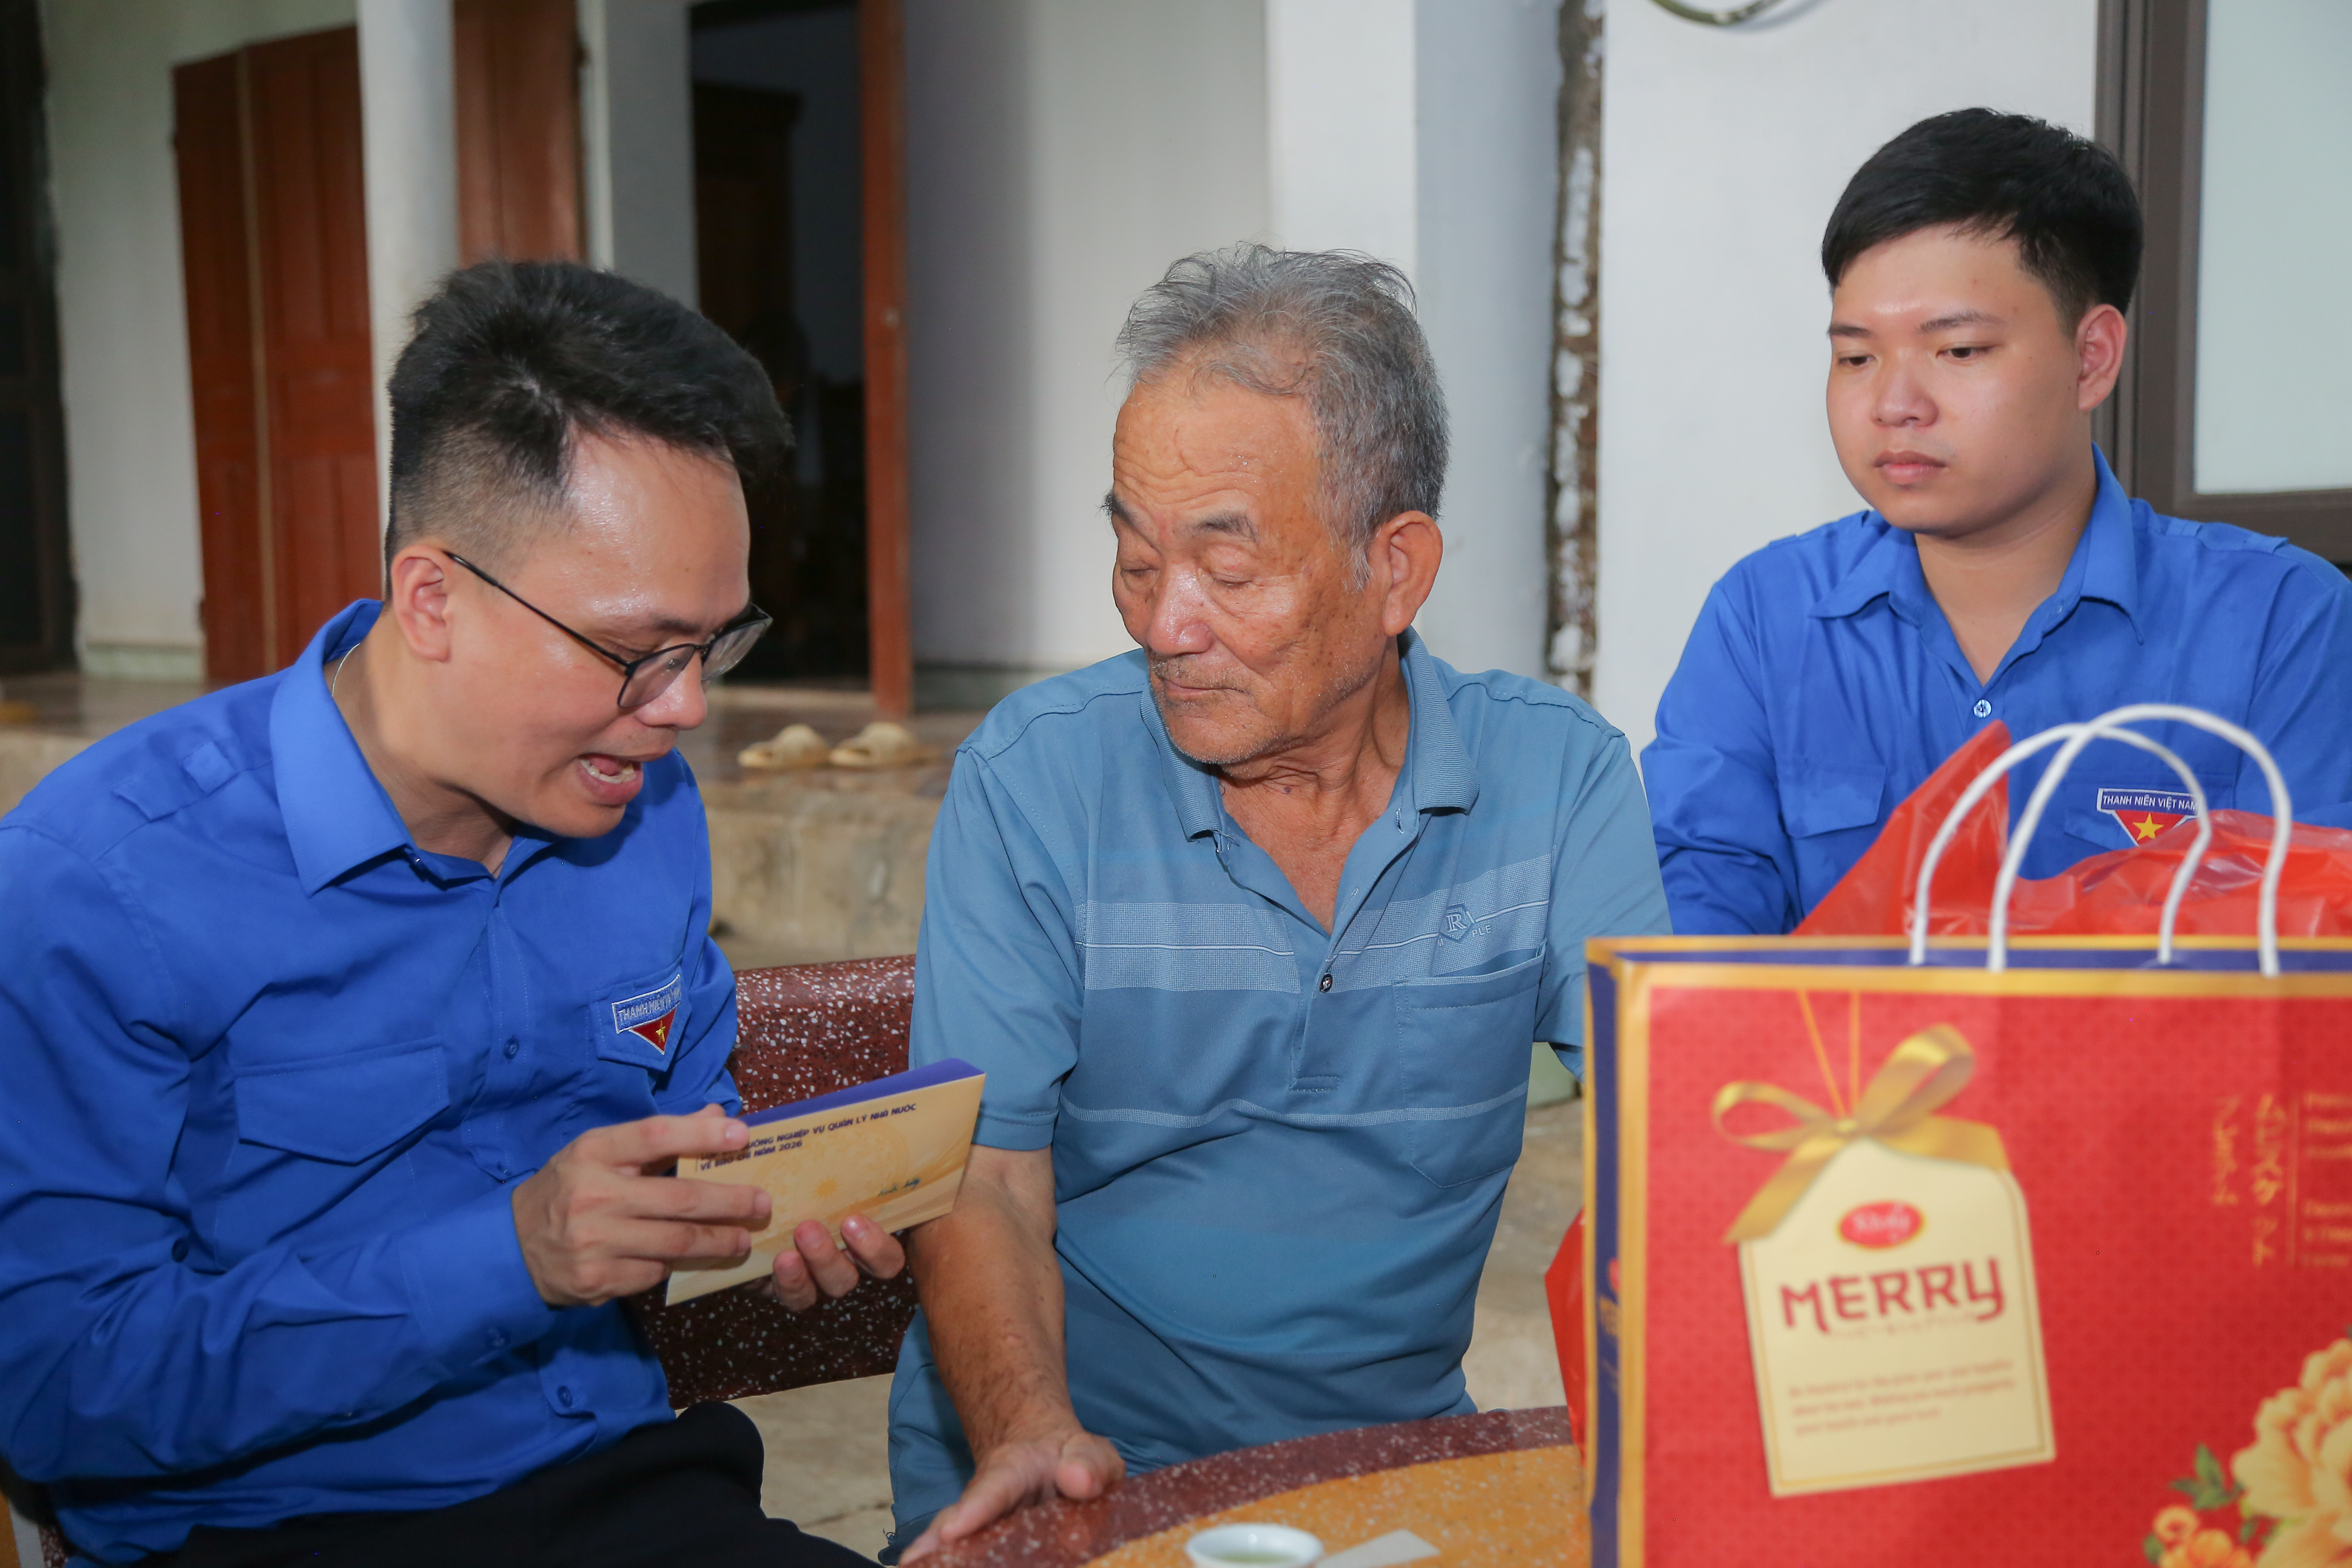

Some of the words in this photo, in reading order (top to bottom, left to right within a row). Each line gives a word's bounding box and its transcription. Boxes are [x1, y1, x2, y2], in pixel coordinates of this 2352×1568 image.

[2103, 795, 2132, 805] THANH
[2134, 794, 2155, 806] NIÊN
[2158, 796, 2177, 810] VIỆT
[2179, 800, 2197, 811] NAM
[1446, 913, 1467, 933] R
[618, 1002, 648, 1022] THANH
[779, 1140, 802, 1152] 2026
[1780, 1257, 2004, 1334] MERRY
